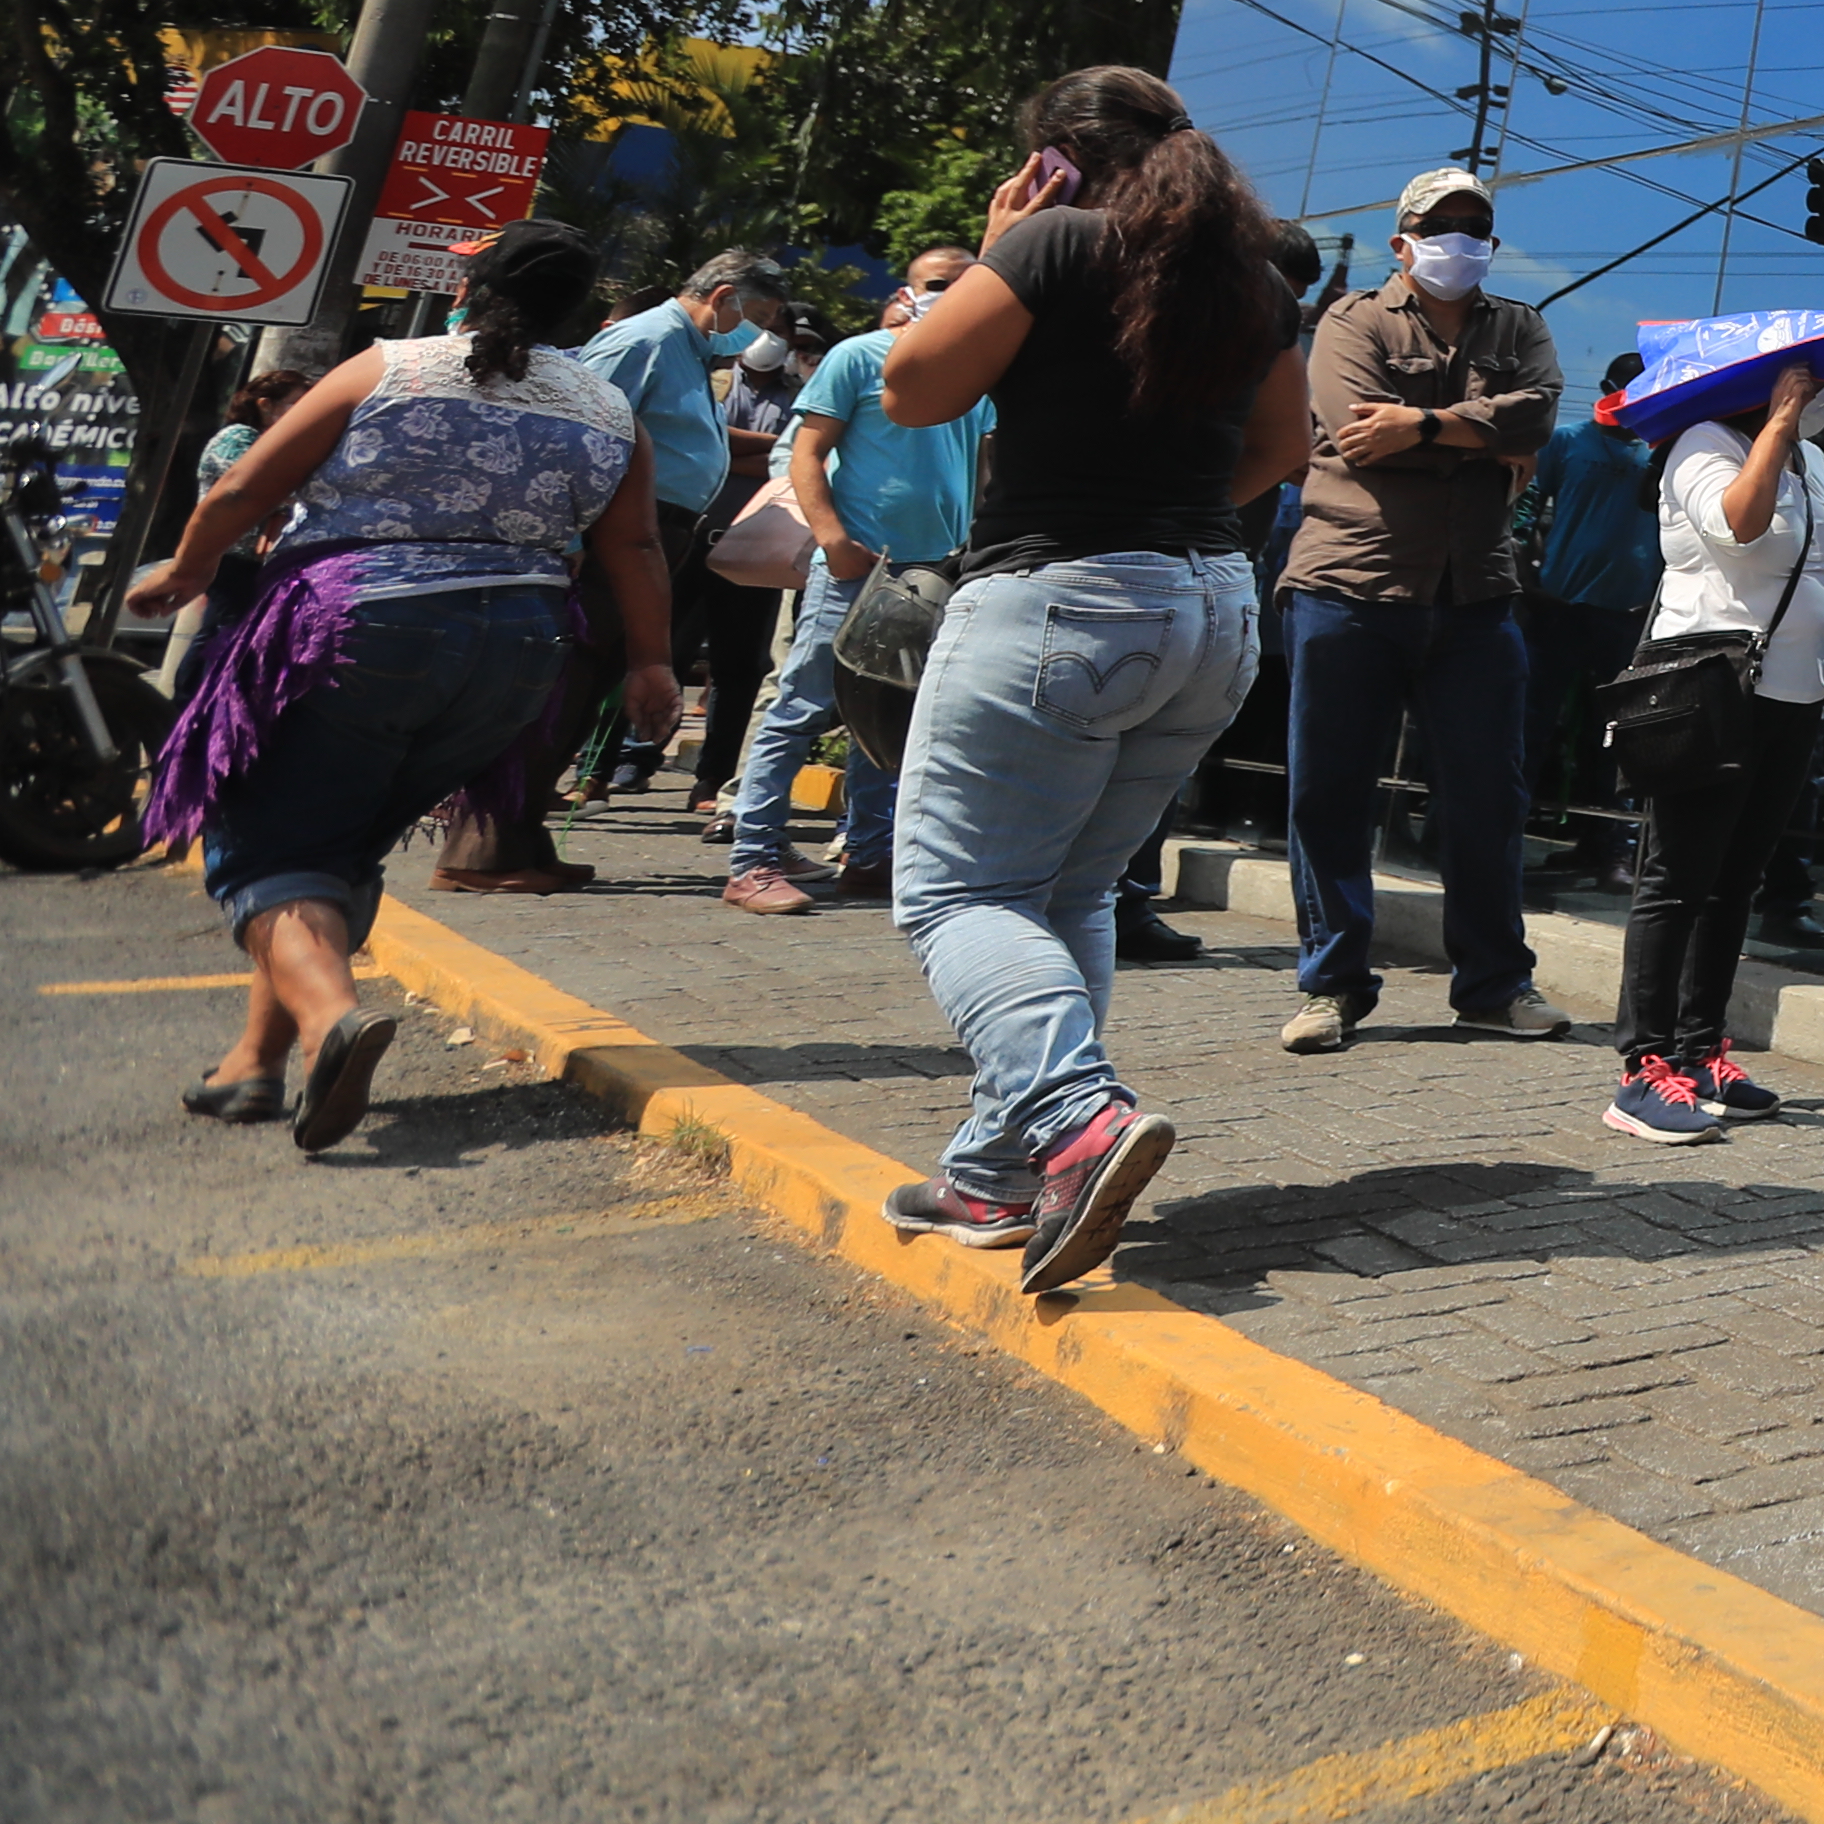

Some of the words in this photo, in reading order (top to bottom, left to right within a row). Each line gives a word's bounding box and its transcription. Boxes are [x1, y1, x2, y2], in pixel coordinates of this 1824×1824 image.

[207, 79, 345, 136] ALTO
[433, 119, 515, 150] CARRIL
[398, 141, 538, 178] REVERSIBLE
[395, 222, 496, 242] HORARI
[379, 250, 399, 263] DE
[363, 273, 381, 285] DE
[373, 262, 382, 273] Y
[384, 263, 403, 276] DE
